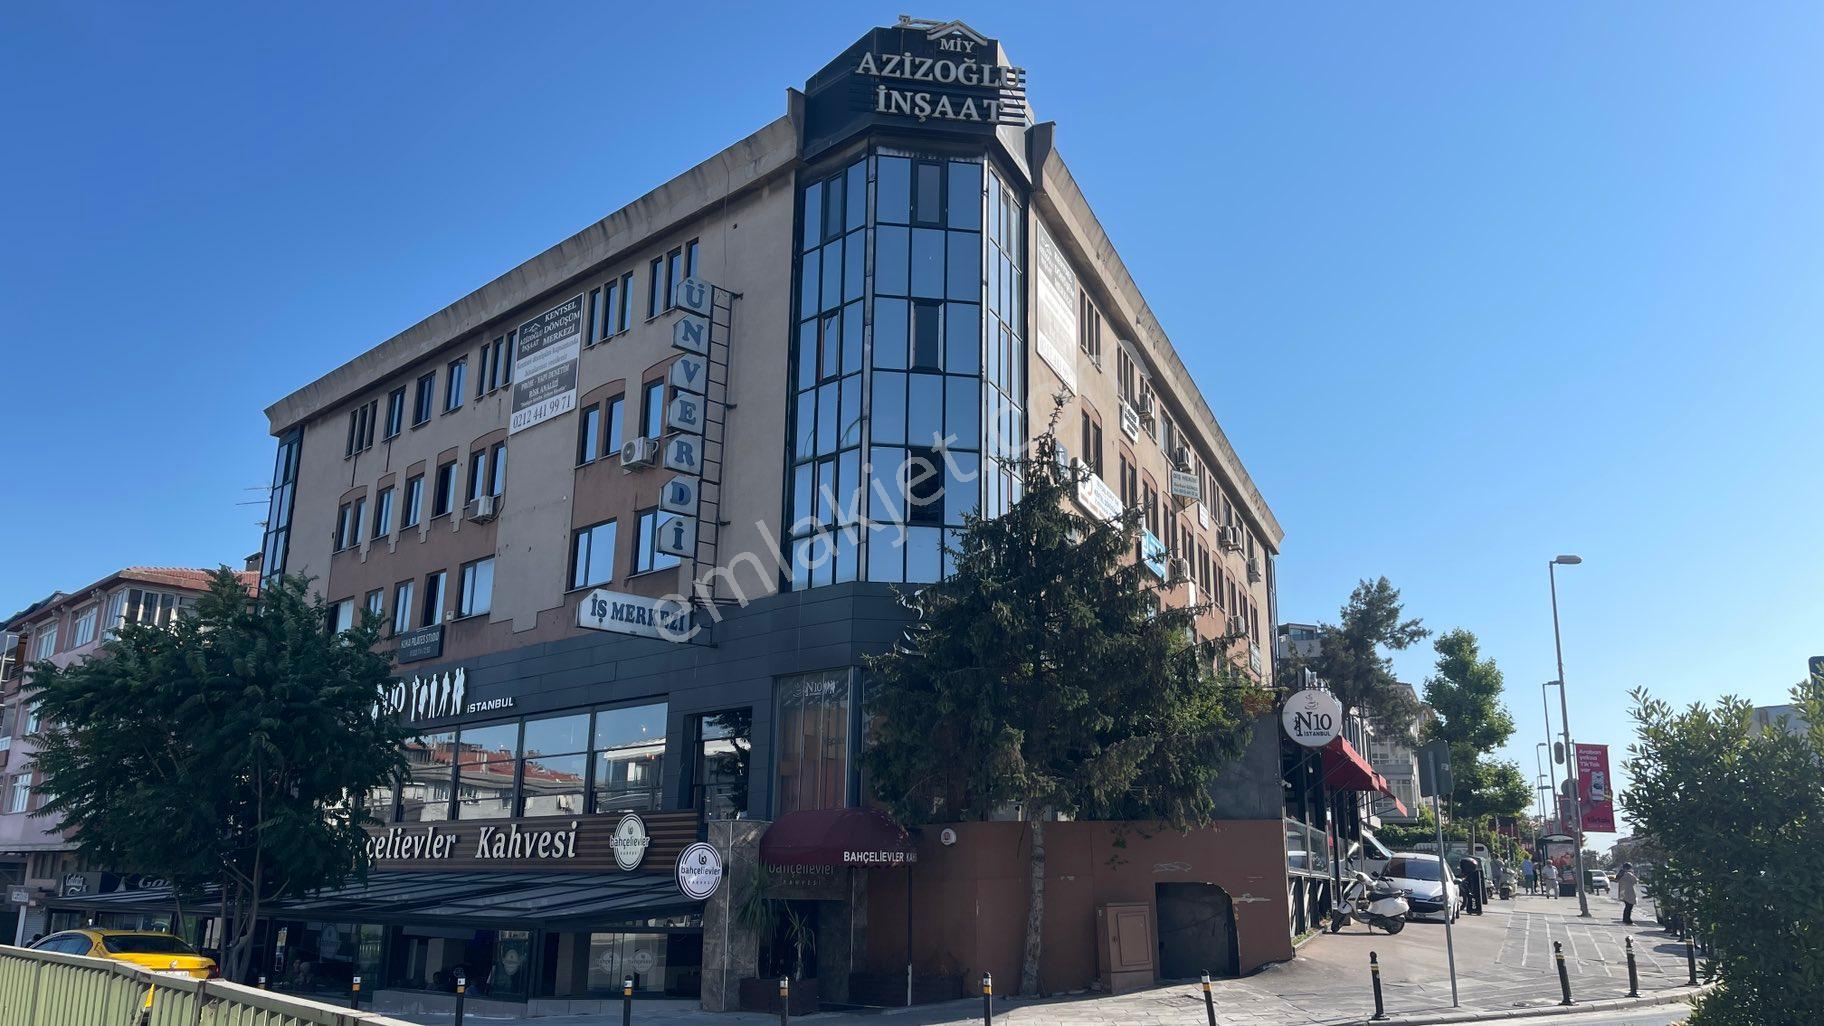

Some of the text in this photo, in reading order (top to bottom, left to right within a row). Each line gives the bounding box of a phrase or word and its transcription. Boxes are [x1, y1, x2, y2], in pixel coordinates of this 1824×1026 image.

[940, 37, 976, 54] MİY
[855, 51, 1023, 89] AZİZOĞLU
[875, 84, 1005, 122] İNŞAAT
[544, 301, 577, 322] KENTSEL
[542, 325, 576, 346] MERKEZİ
[513, 410, 531, 430] 0212
[534, 404, 547, 421] 441
[549, 398, 560, 414] 99
[561, 393, 571, 409] 71
[670, 278, 706, 551] ÜNVERDİ
[590, 593, 608, 623] İŞ
[1294, 711, 1333, 733] N10
[366, 820, 578, 867] çelievler Kahvesi
[843, 850, 904, 864] BAHÇELİEVLER
[680, 865, 721, 876] bahçelievler
